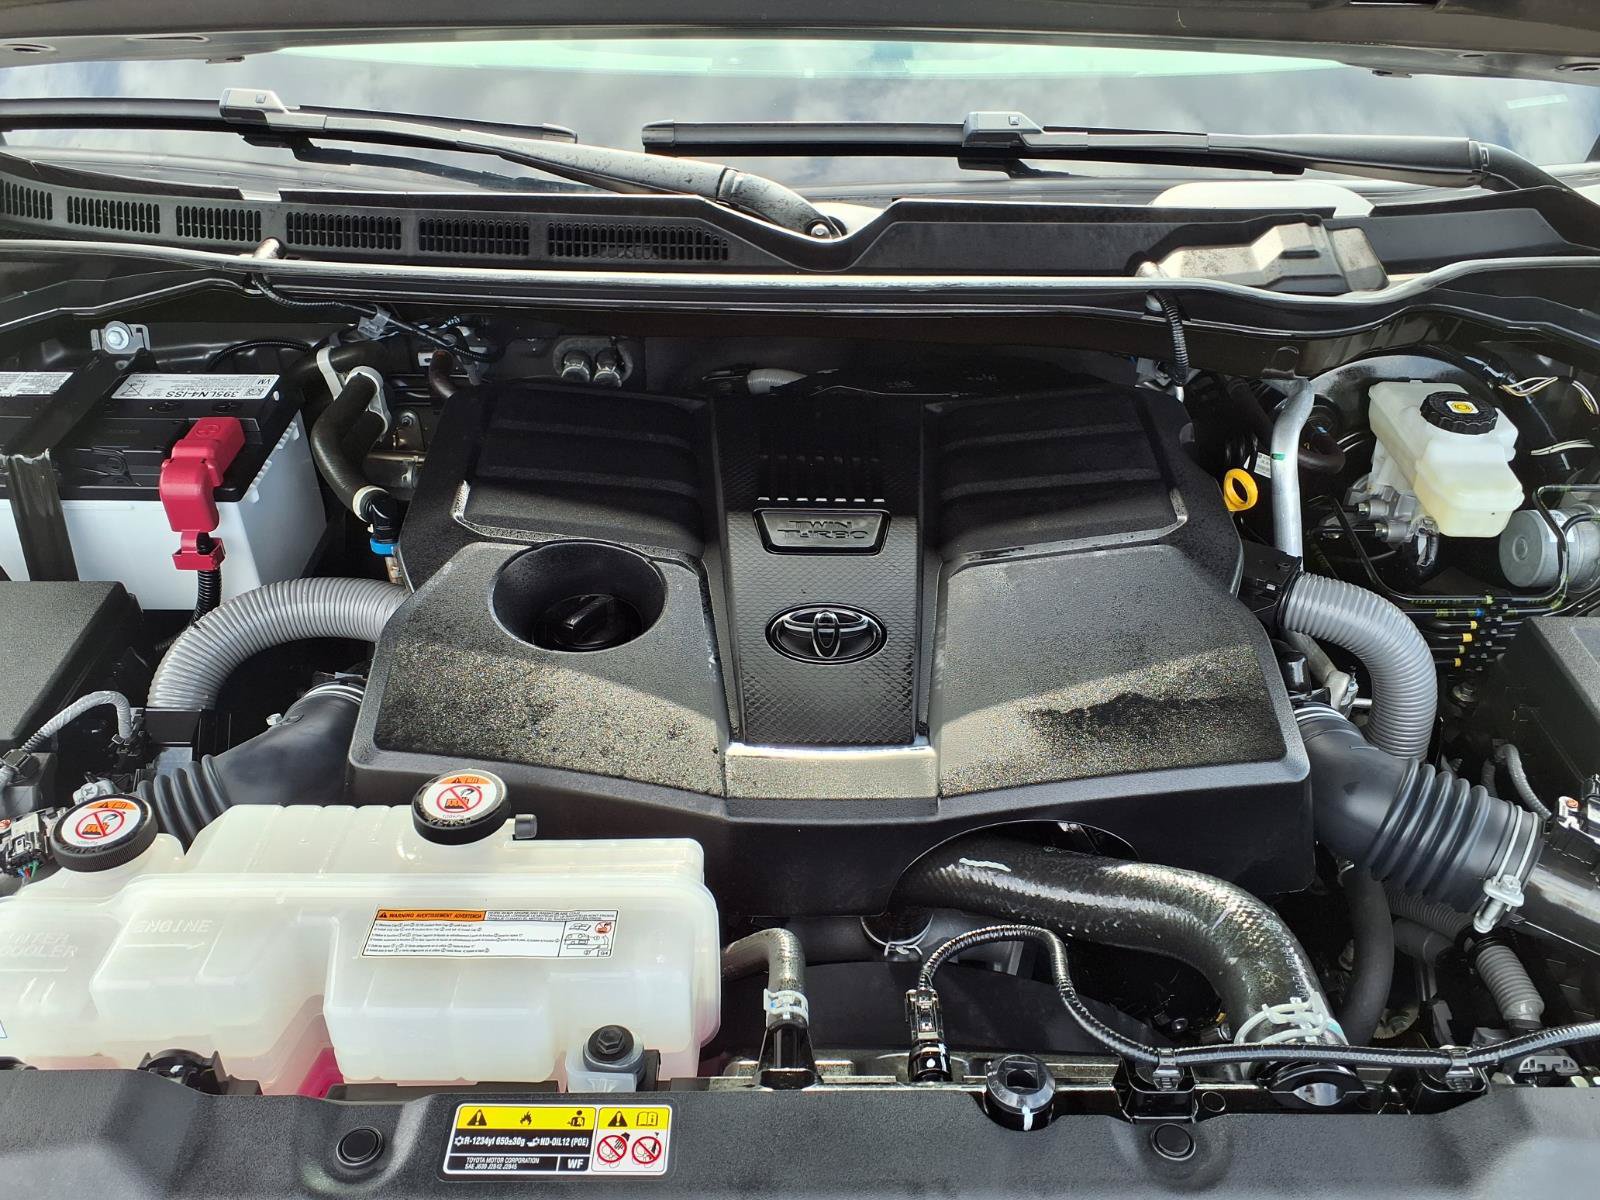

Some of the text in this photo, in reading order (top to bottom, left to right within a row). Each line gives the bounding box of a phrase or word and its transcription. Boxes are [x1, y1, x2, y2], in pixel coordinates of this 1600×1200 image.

[788, 520, 852, 529] TWIN
[777, 529, 869, 539] TURBO
[132, 919, 214, 934] ENGINE
[463, 1135, 495, 1147] R-1234yf
[540, 1137, 570, 1146] ND-OIL12
[570, 1137, 589, 1148] (POE)
[567, 1158, 584, 1170] WF
